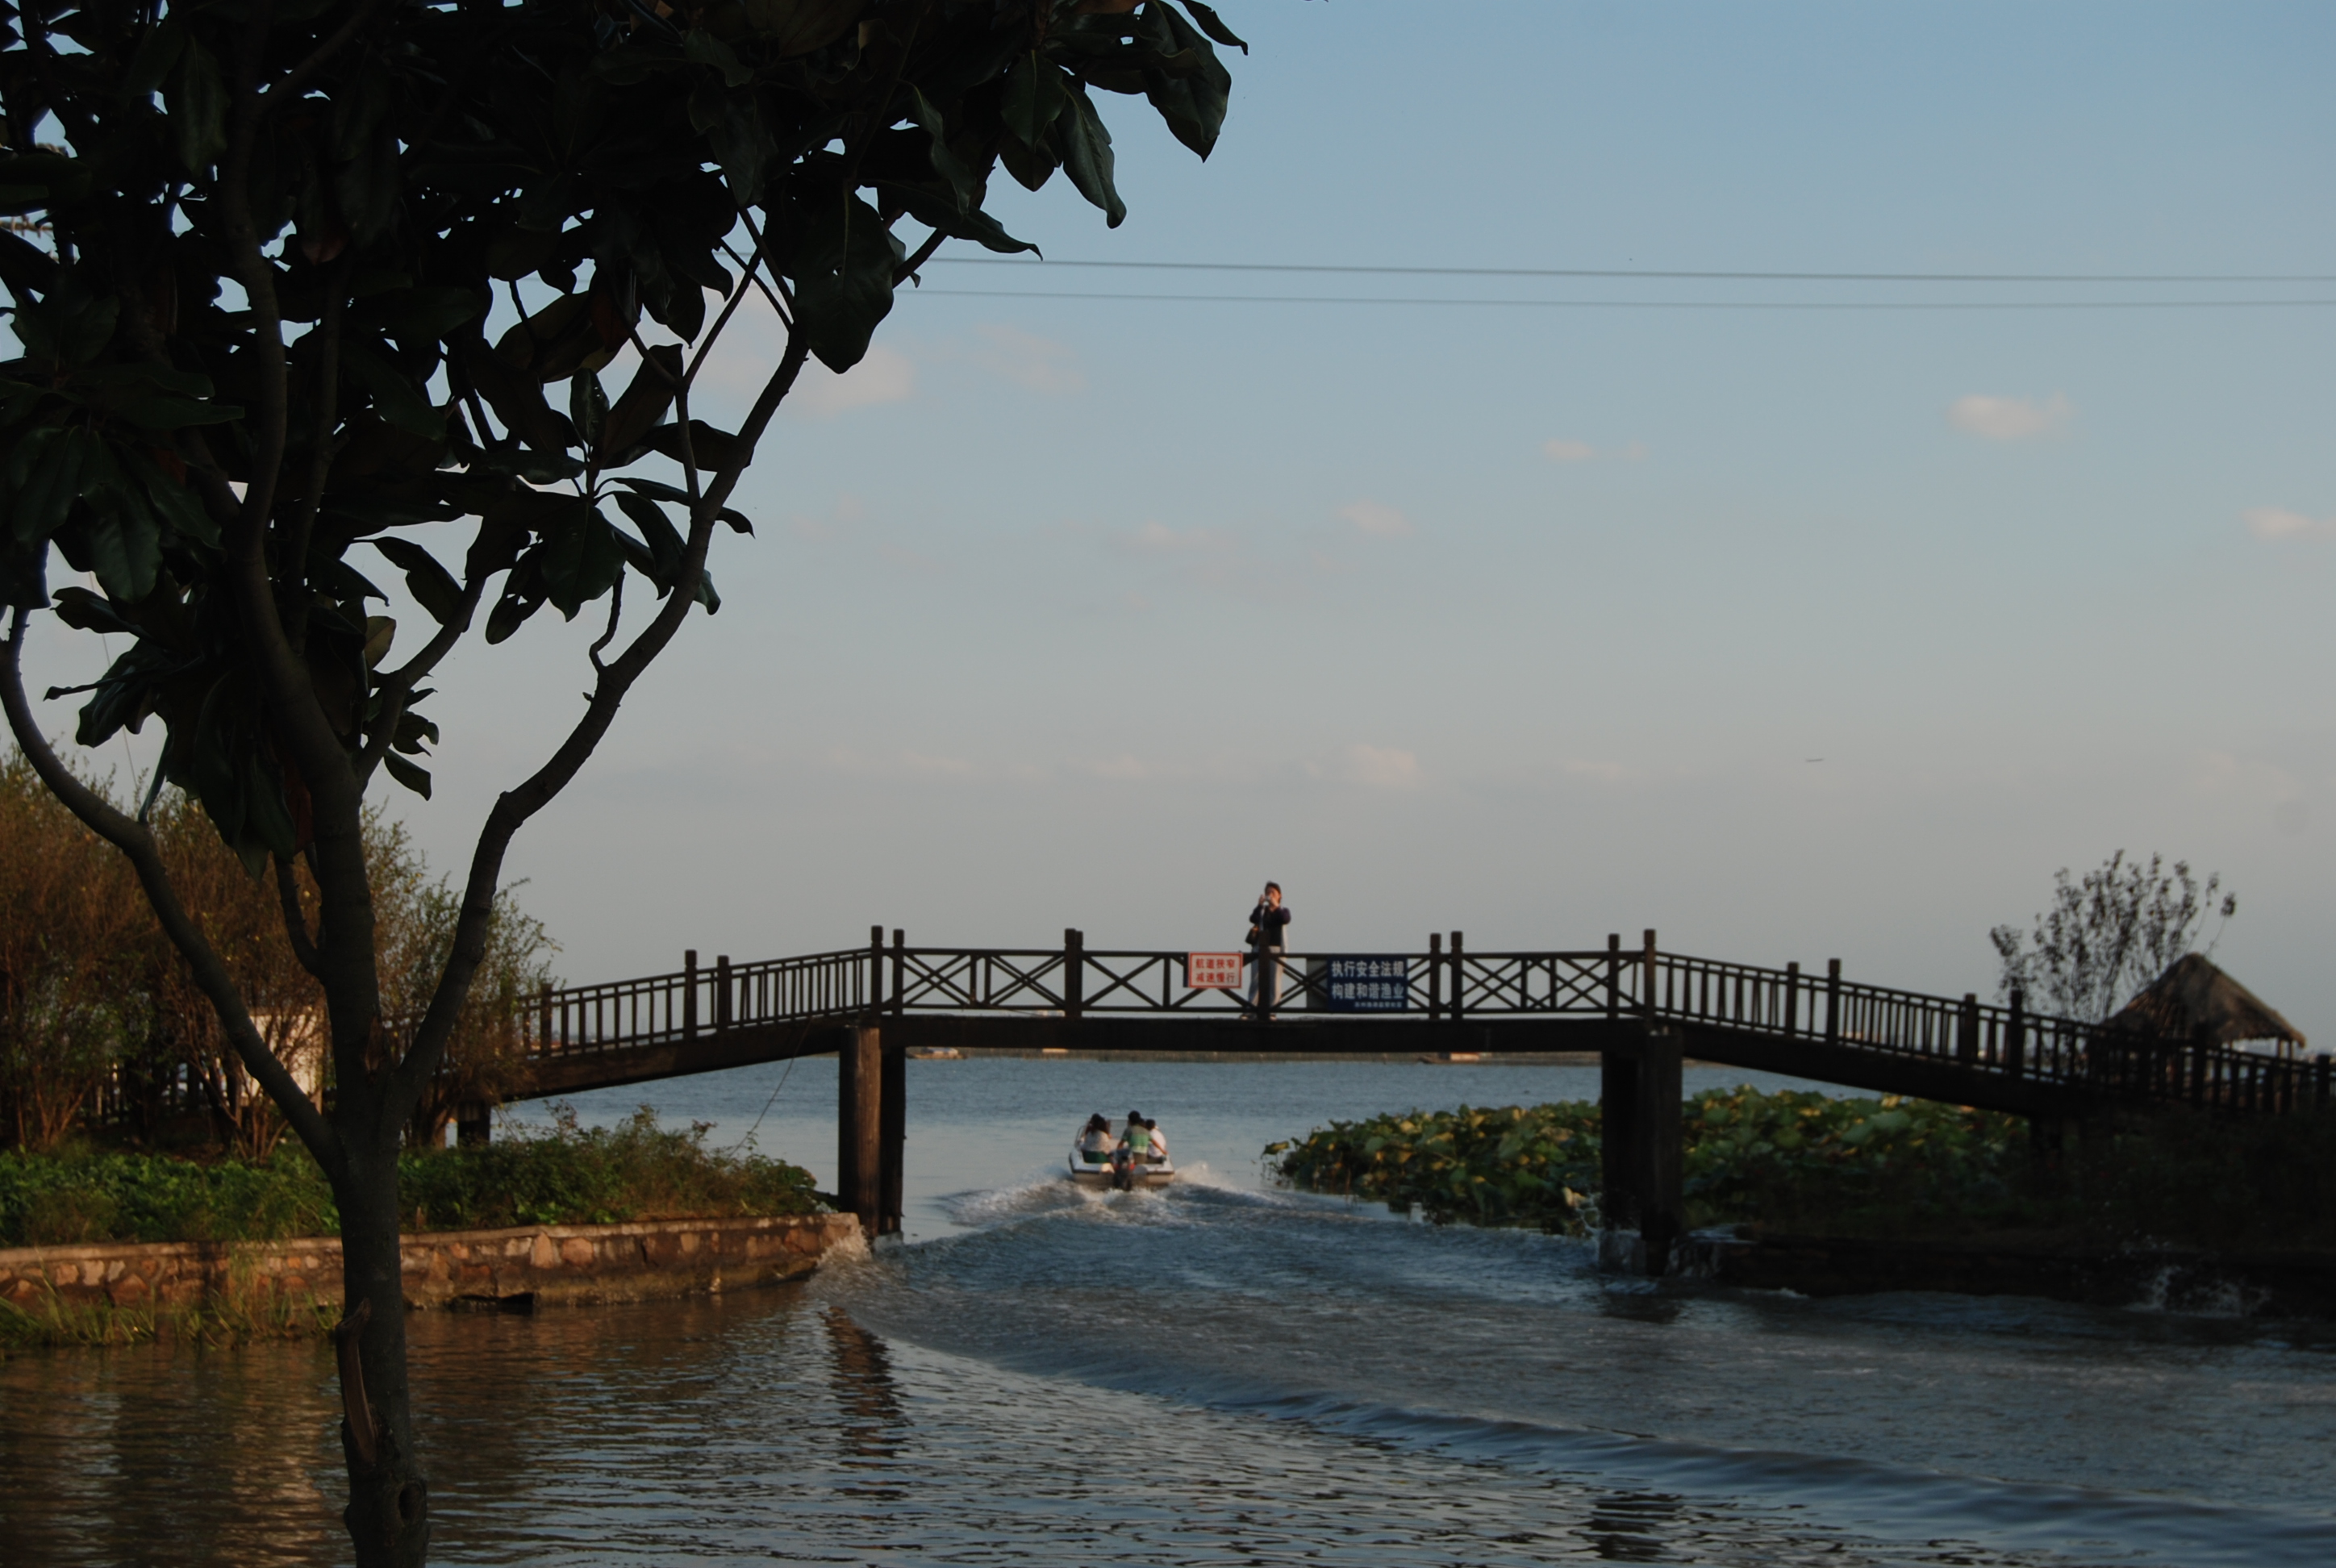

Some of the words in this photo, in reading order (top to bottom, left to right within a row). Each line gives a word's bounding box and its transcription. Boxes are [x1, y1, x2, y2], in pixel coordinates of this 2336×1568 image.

[1195, 972, 1235, 983] 减速慢行
[1331, 960, 1404, 978] 执行安全法规
[1331, 982, 1404, 999] 构建和谐渔业
